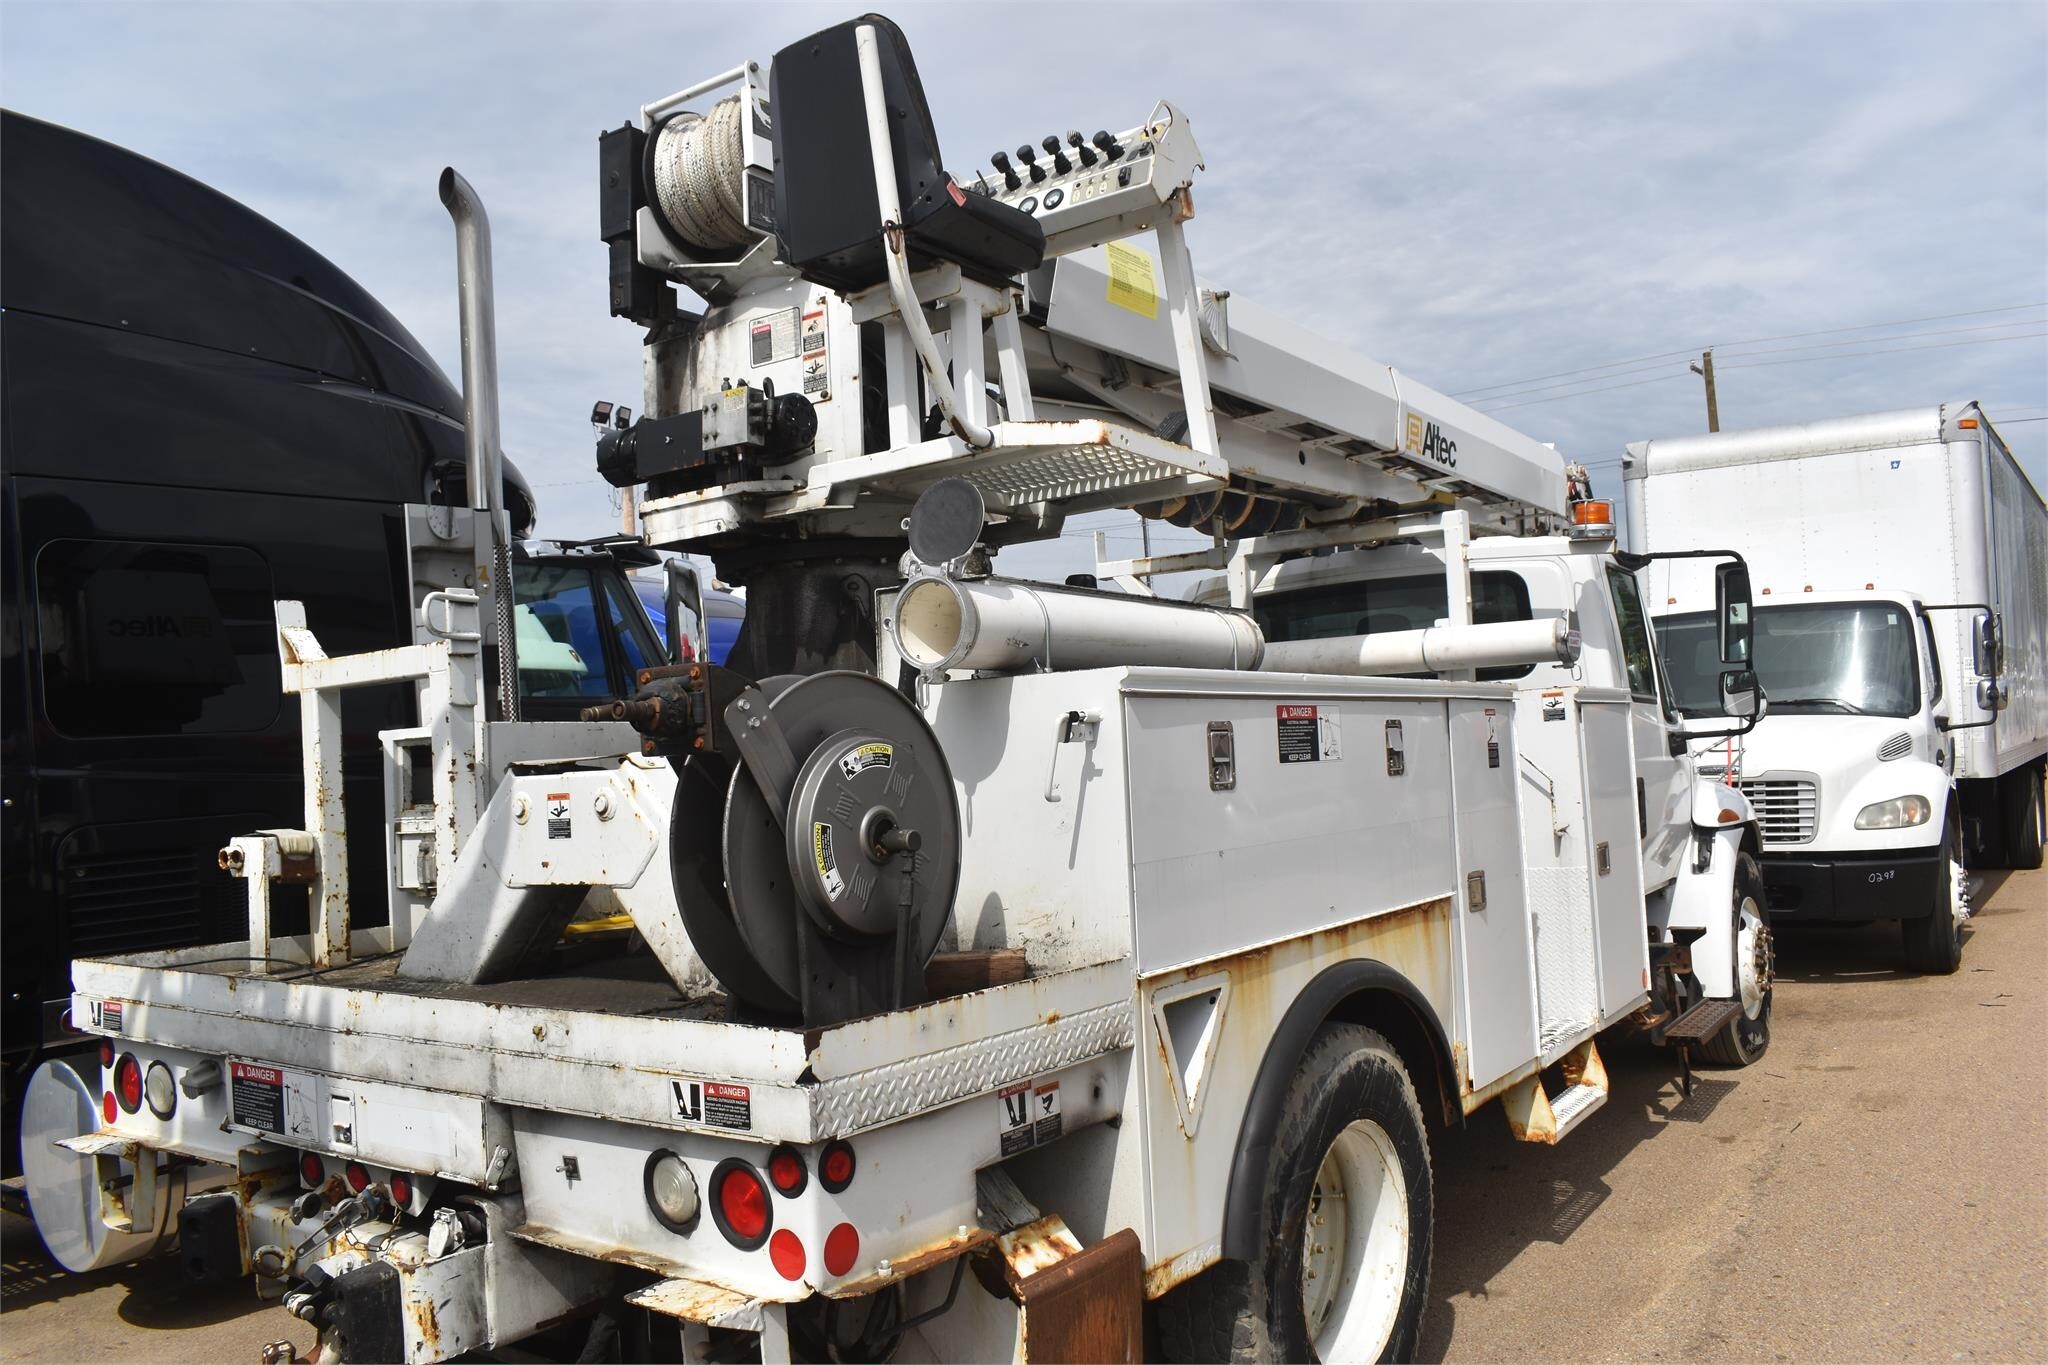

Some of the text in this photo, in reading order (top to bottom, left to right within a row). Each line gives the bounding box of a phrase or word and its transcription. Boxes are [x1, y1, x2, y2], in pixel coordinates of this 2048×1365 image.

[1422, 421, 1457, 468] Altec
[1289, 706, 1313, 718] DANGER
[816, 827, 824, 865] CAUTION
[246, 1066, 276, 1081] DANGER
[719, 1086, 746, 1097] DANGER
[244, 1117, 274, 1130] KEEP CLEAR
